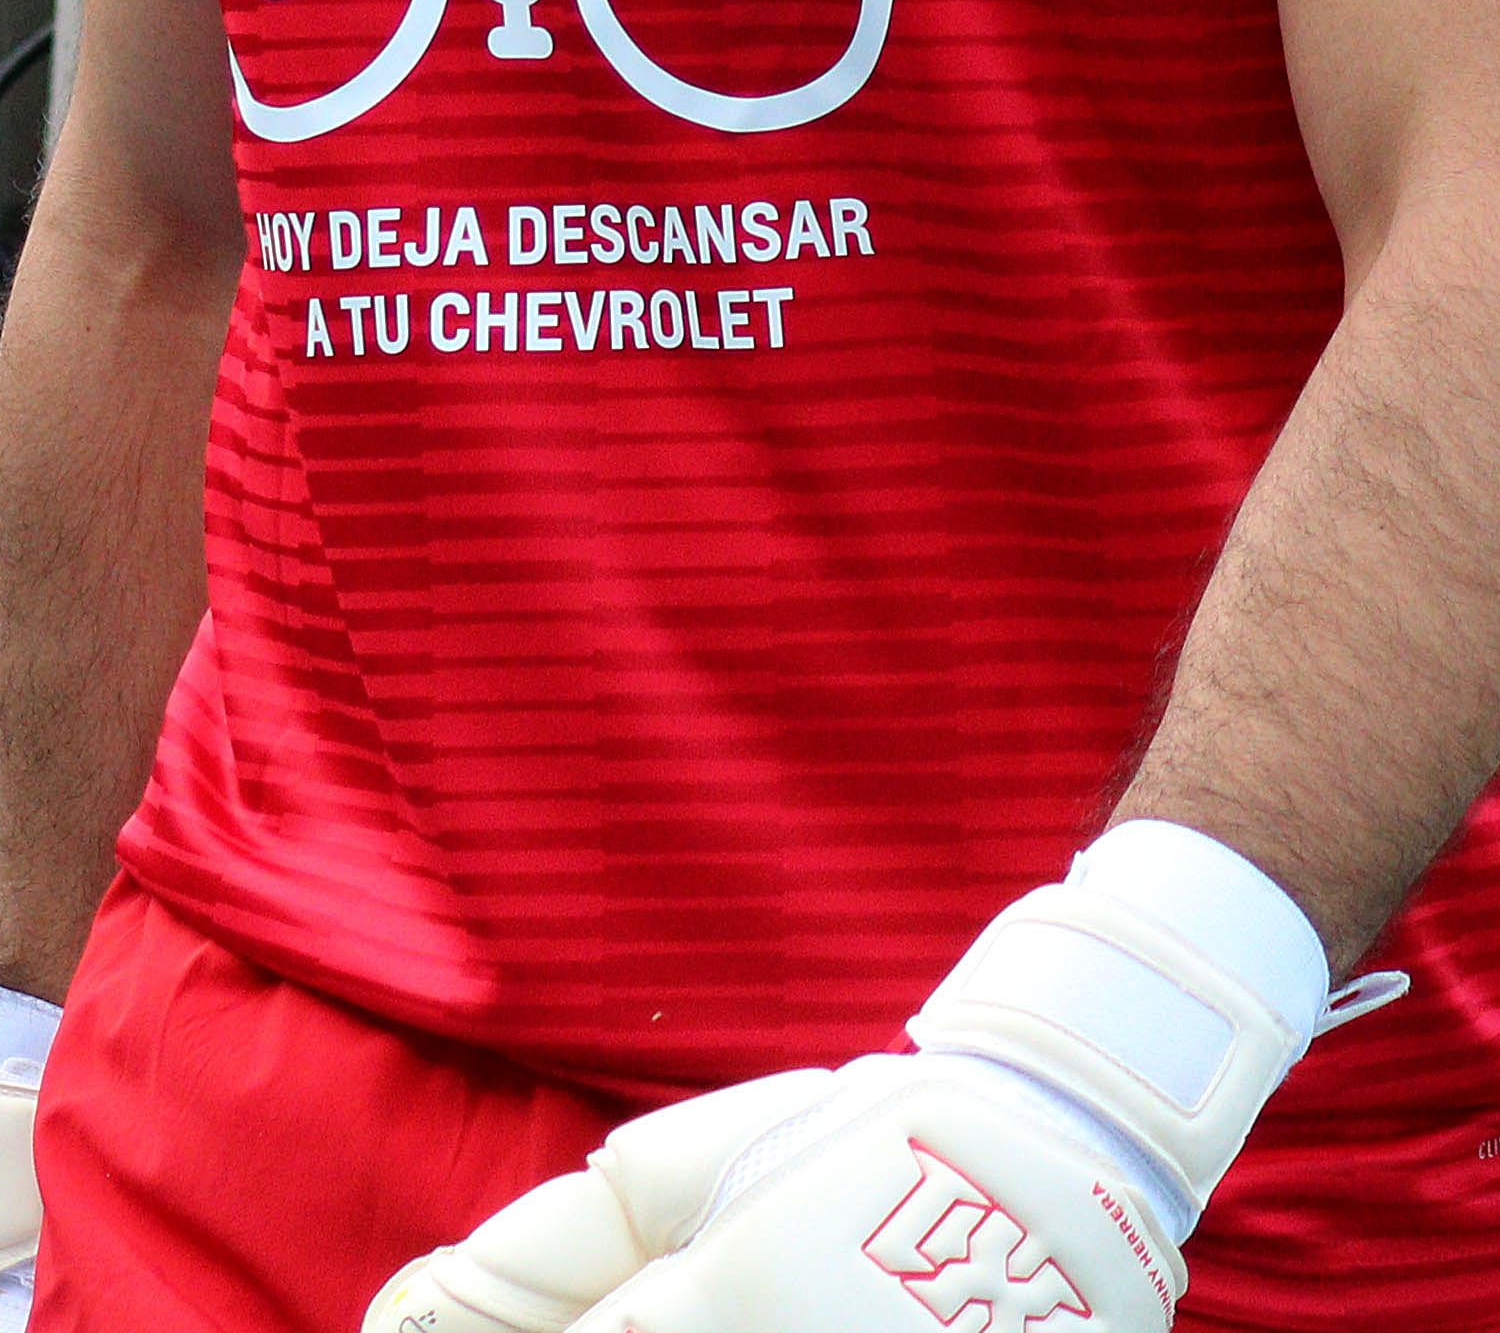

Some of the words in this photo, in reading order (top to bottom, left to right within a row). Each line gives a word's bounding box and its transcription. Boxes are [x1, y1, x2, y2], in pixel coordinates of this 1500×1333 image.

[255, 211, 316, 274] HOY
[329, 206, 490, 270] DEJA
[508, 197, 876, 266] DESCANSAR
[304, 296, 335, 359] A
[339, 293, 411, 357] TU
[429, 286, 795, 354] CHEVROLET
[1091, 1180, 1154, 1269] HERRERA
